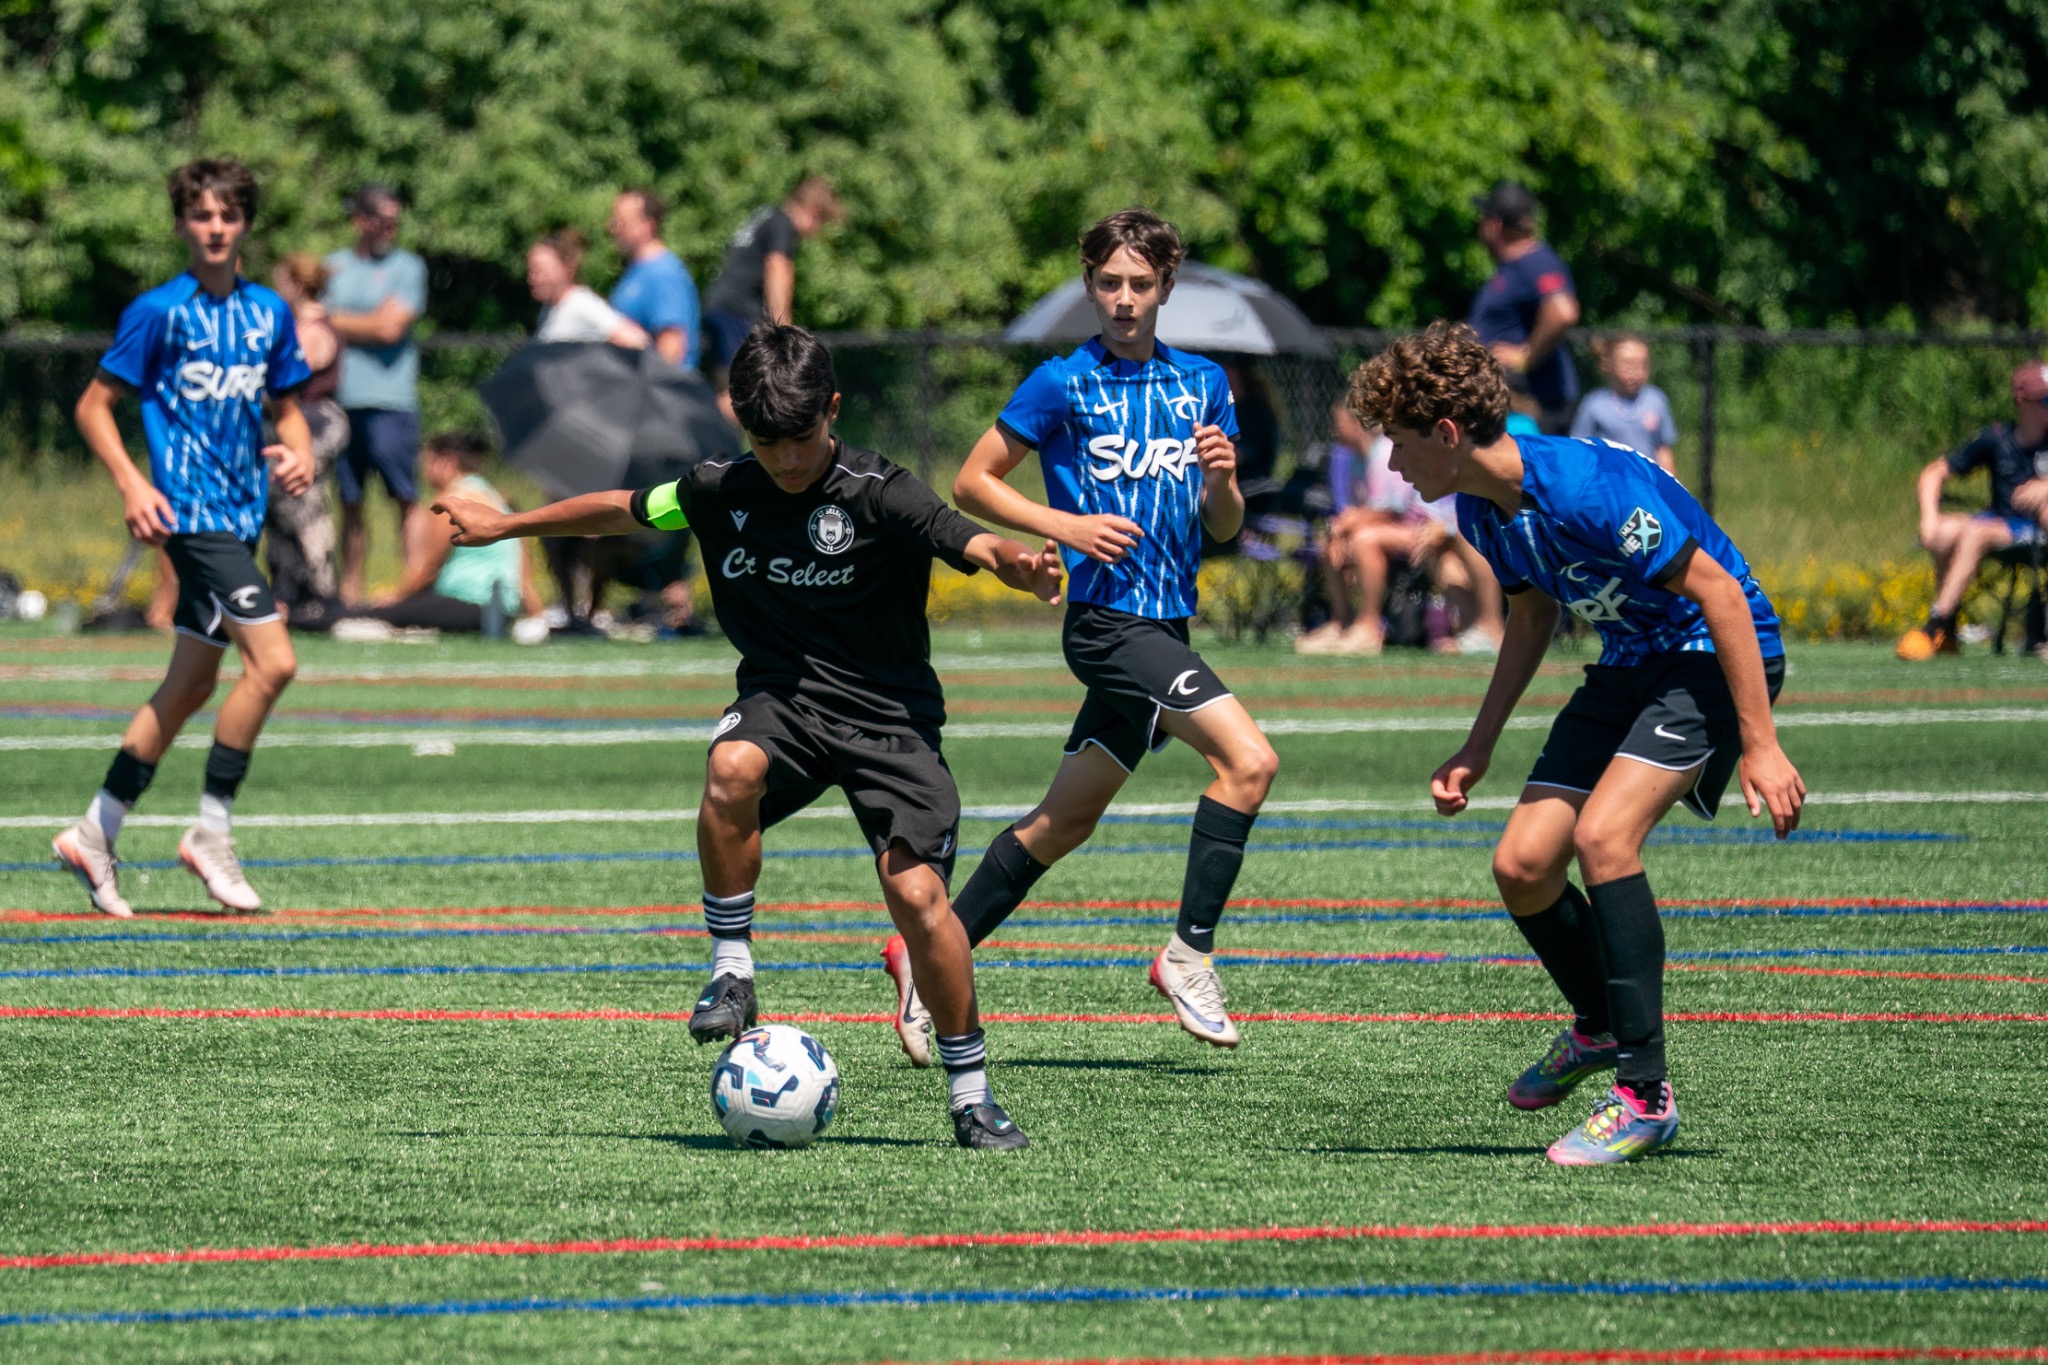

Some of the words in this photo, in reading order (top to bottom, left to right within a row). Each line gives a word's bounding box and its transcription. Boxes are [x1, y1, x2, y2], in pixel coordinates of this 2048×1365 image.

[181, 361, 269, 401] SURF
[1621, 520, 1637, 537] MLS
[722, 547, 757, 579] Ct
[767, 557, 854, 586] Select
